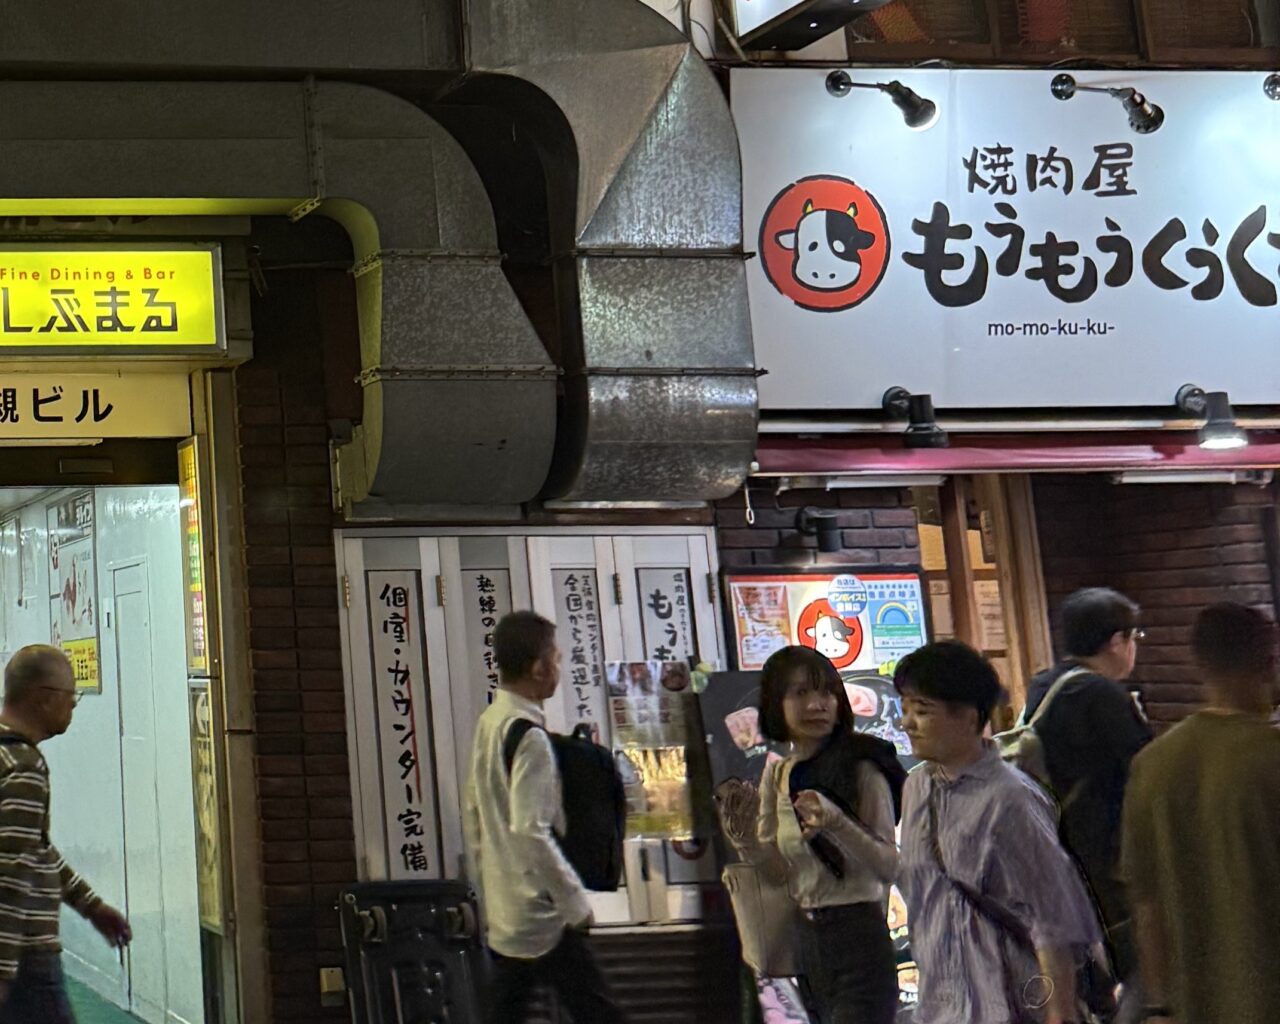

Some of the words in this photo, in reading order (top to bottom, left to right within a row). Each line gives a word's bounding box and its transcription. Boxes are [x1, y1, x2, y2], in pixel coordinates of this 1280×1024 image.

[963, 141, 1138, 198] 焼肉屋
[0, 268, 40, 281] Fine
[50, 267, 115, 283] Dining
[125, 269, 134, 280] &
[143, 267, 175, 280] Bar
[901, 201, 1280, 308] もうもうくうく
[1, 286, 178, 333] しぶまる
[987, 318, 1115, 337] mo-mo-ku-ku-
[380, 583, 428, 871] 個室・カウンター完備
